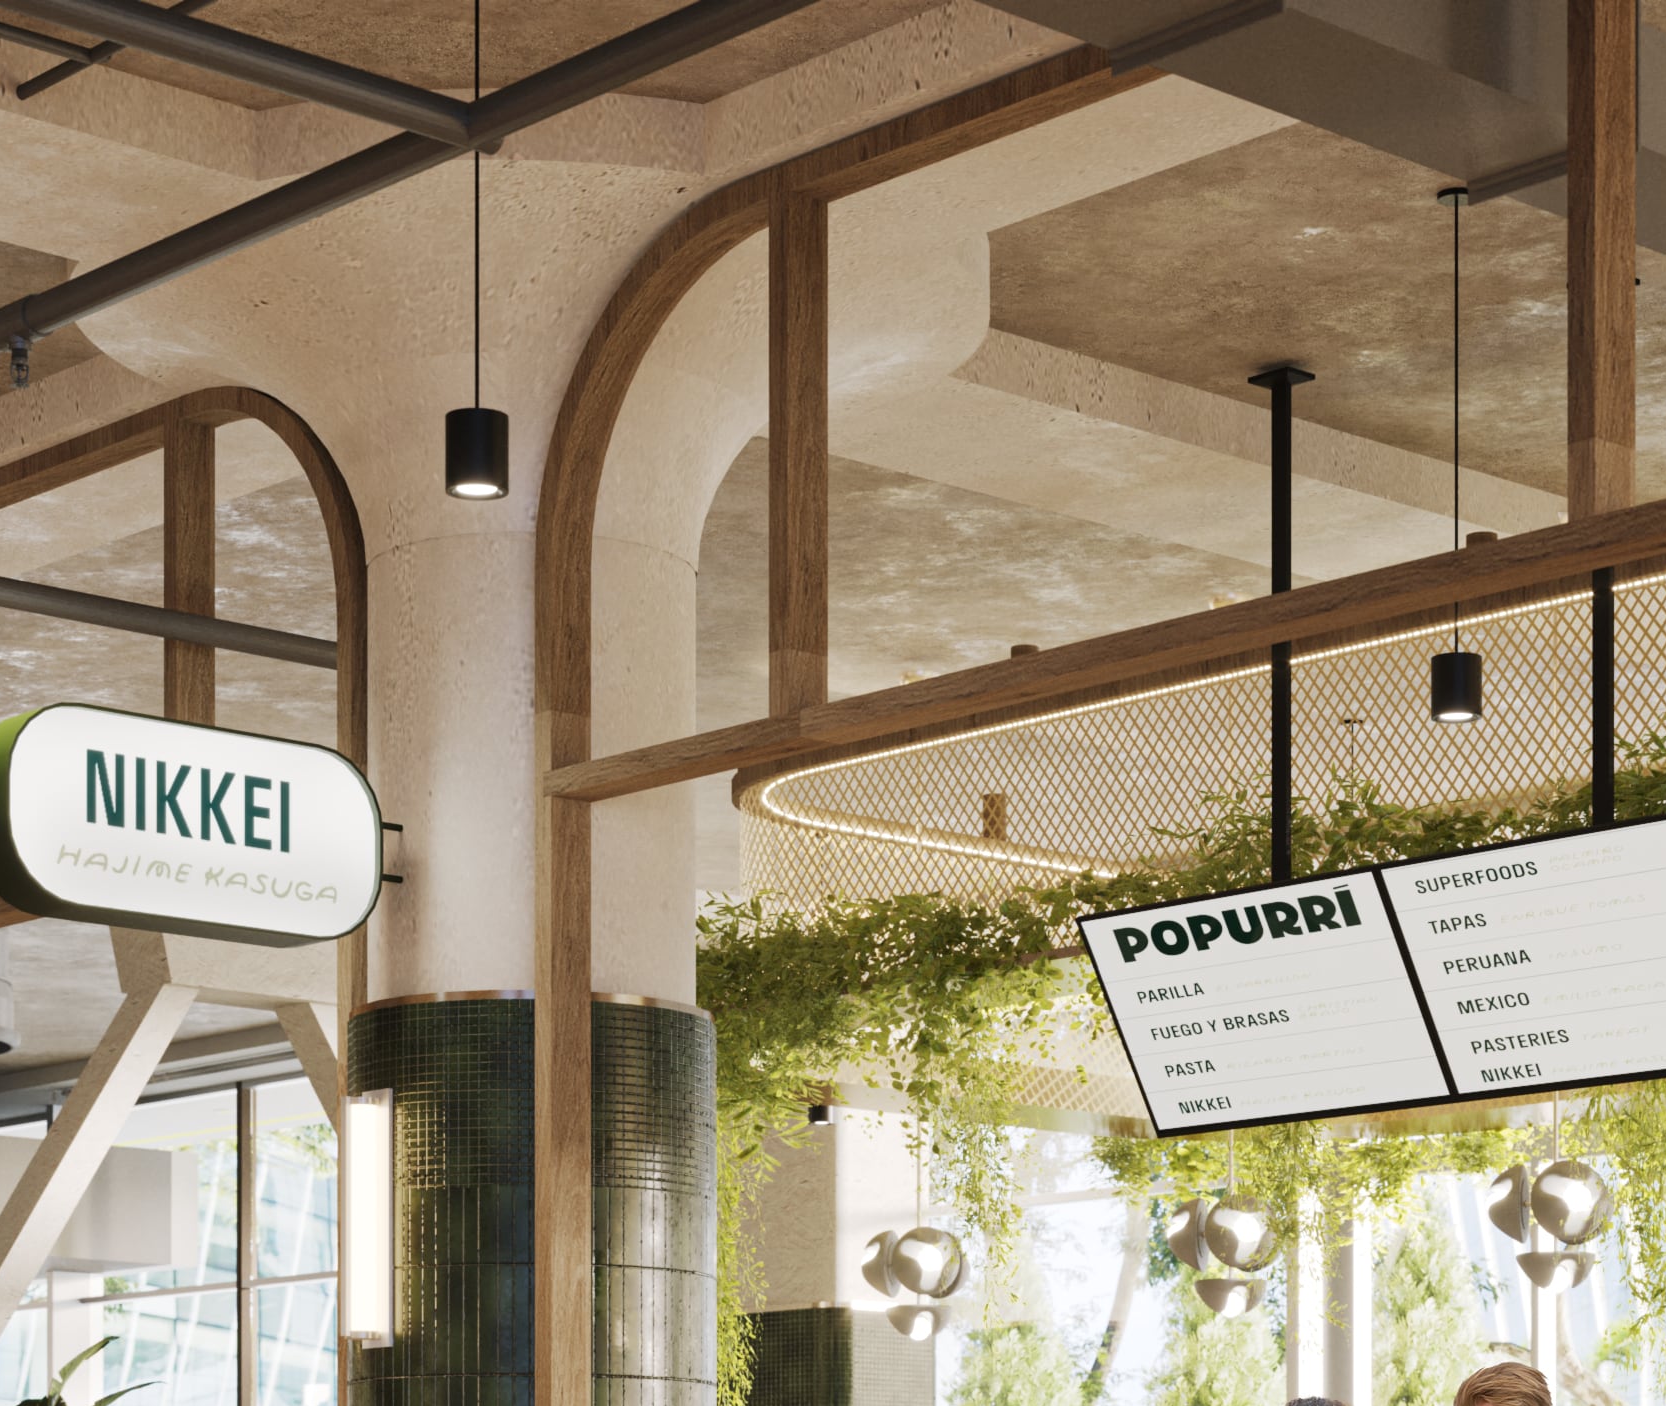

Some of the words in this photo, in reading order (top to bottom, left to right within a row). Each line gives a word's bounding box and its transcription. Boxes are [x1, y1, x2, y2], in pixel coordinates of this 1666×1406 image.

[86, 749, 290, 853] NIKKEI
[57, 844, 193, 884] HAJIME
[204, 867, 338, 904] KASUGA
[1415, 861, 1537, 894] SUPERFOODS
[1428, 914, 1487, 934] TAPAS
[1443, 950, 1531, 974] PERUANA
[1137, 983, 1205, 1004] PARILLA
[1457, 992, 1529, 1014] MEXICO
[1151, 1022, 1203, 1040] FUEGO
[1207, 1020, 1216, 1032] Y
[1223, 1010, 1289, 1030] BRASAS
[1471, 1030, 1569, 1054] PASTERIES
[1165, 1060, 1216, 1078] PASTA
[1481, 1064, 1541, 1083] NIKKEI
[1178, 1096, 1231, 1114] NIKKEI
